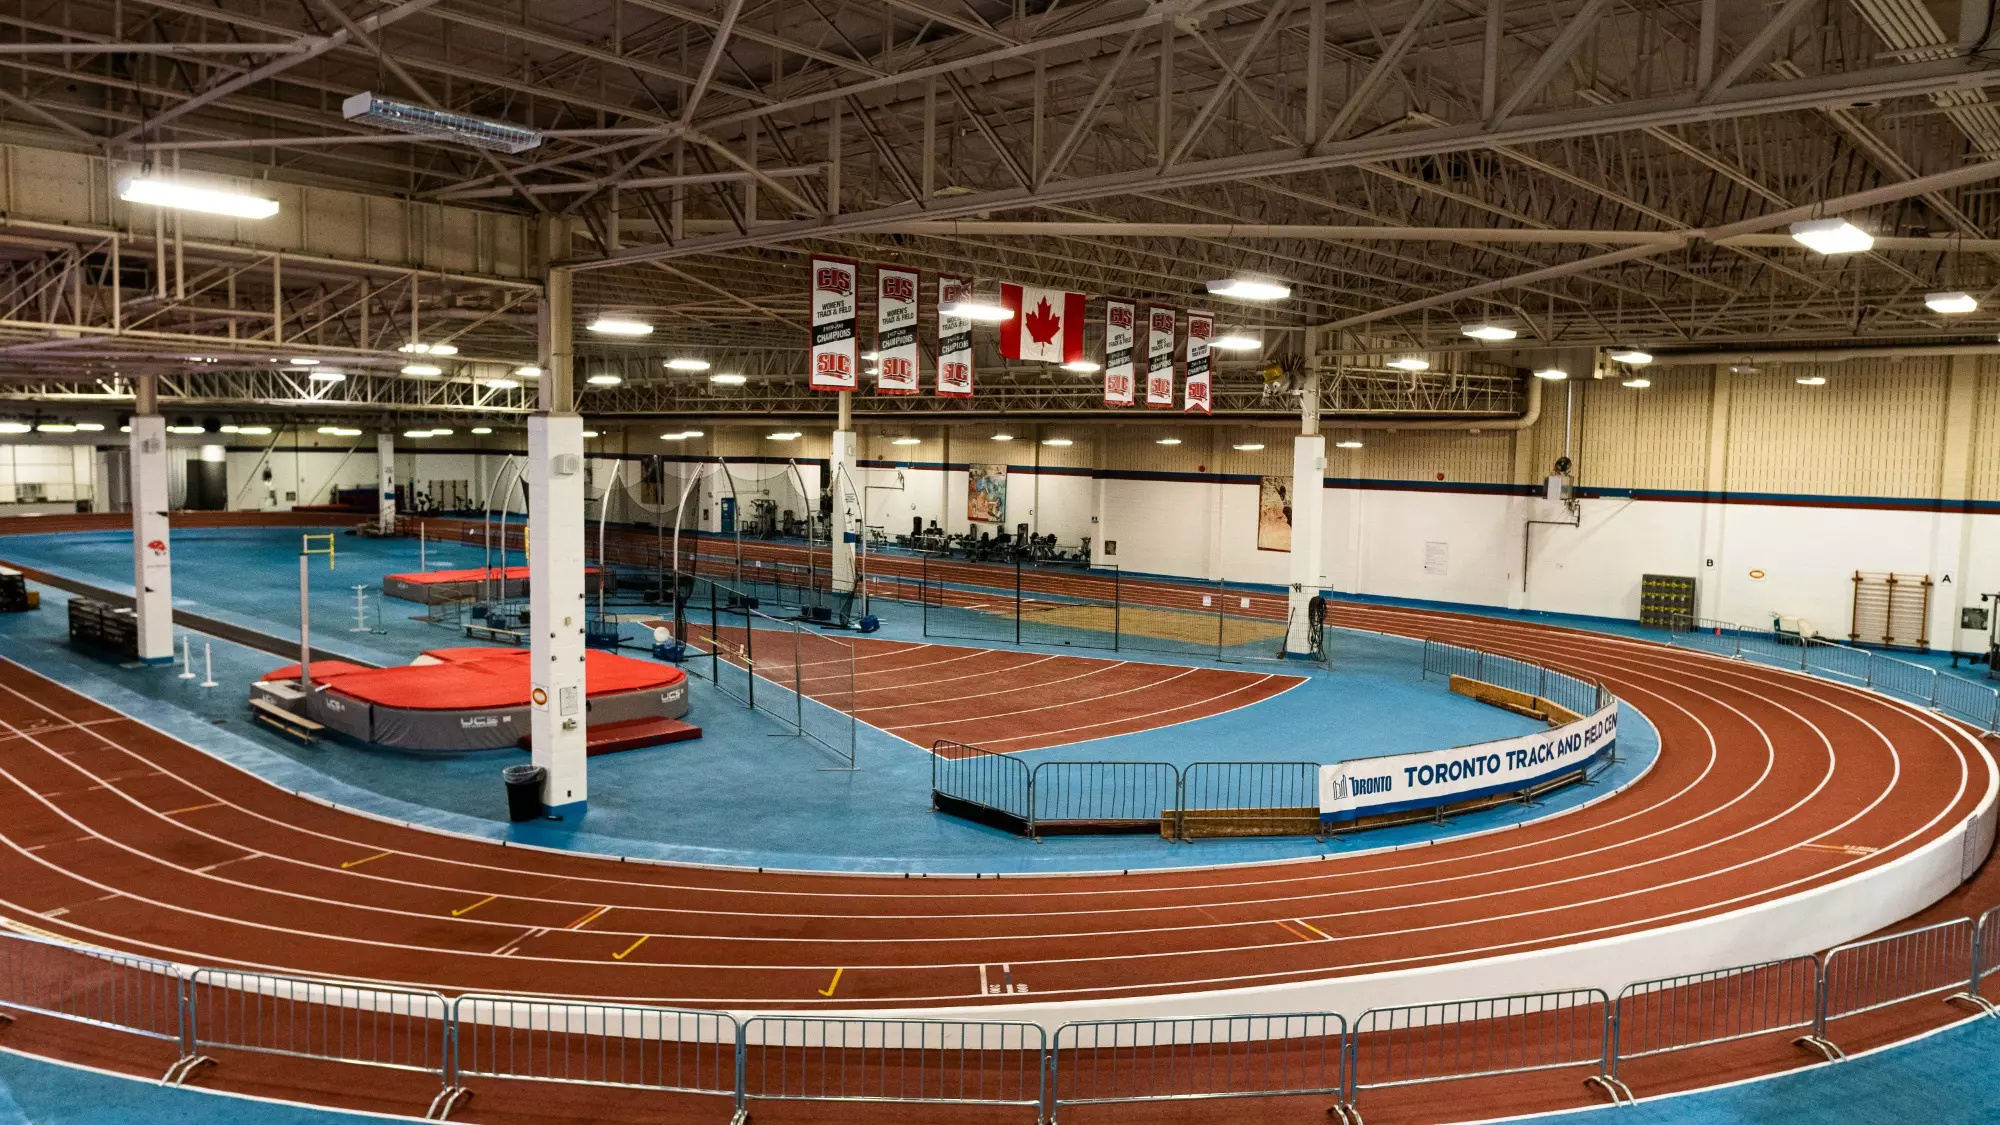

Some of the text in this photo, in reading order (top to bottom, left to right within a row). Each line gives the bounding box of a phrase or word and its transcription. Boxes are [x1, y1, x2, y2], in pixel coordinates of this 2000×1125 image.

[817, 268, 850, 290] CIS
[882, 276, 914, 297] CIS
[817, 310, 832, 318] TRACK
[839, 306, 852, 314] FIELD
[822, 300, 845, 311] WOMEN'S
[887, 307, 907, 317] WOMEN'S
[882, 316, 895, 325] TRACK
[1110, 307, 1132, 324] CIS
[817, 329, 851, 343] CHAMPIONS
[882, 335, 913, 349] CHAMPIONS
[817, 352, 850, 374] SIC
[882, 357, 913, 377] SIC
[1108, 375, 1129, 391] SIC
[1188, 382, 1208, 397] SIC
[1706, 559, 1713, 567] B
[1942, 575, 1951, 583] A
[1404, 754, 1500, 787] TORONTO
[1506, 742, 1554, 771] TRACK
[1557, 733, 1582, 757] AND
[1585, 721, 1603, 748] FIELD
[1349, 776, 1392, 797] TORONTO
